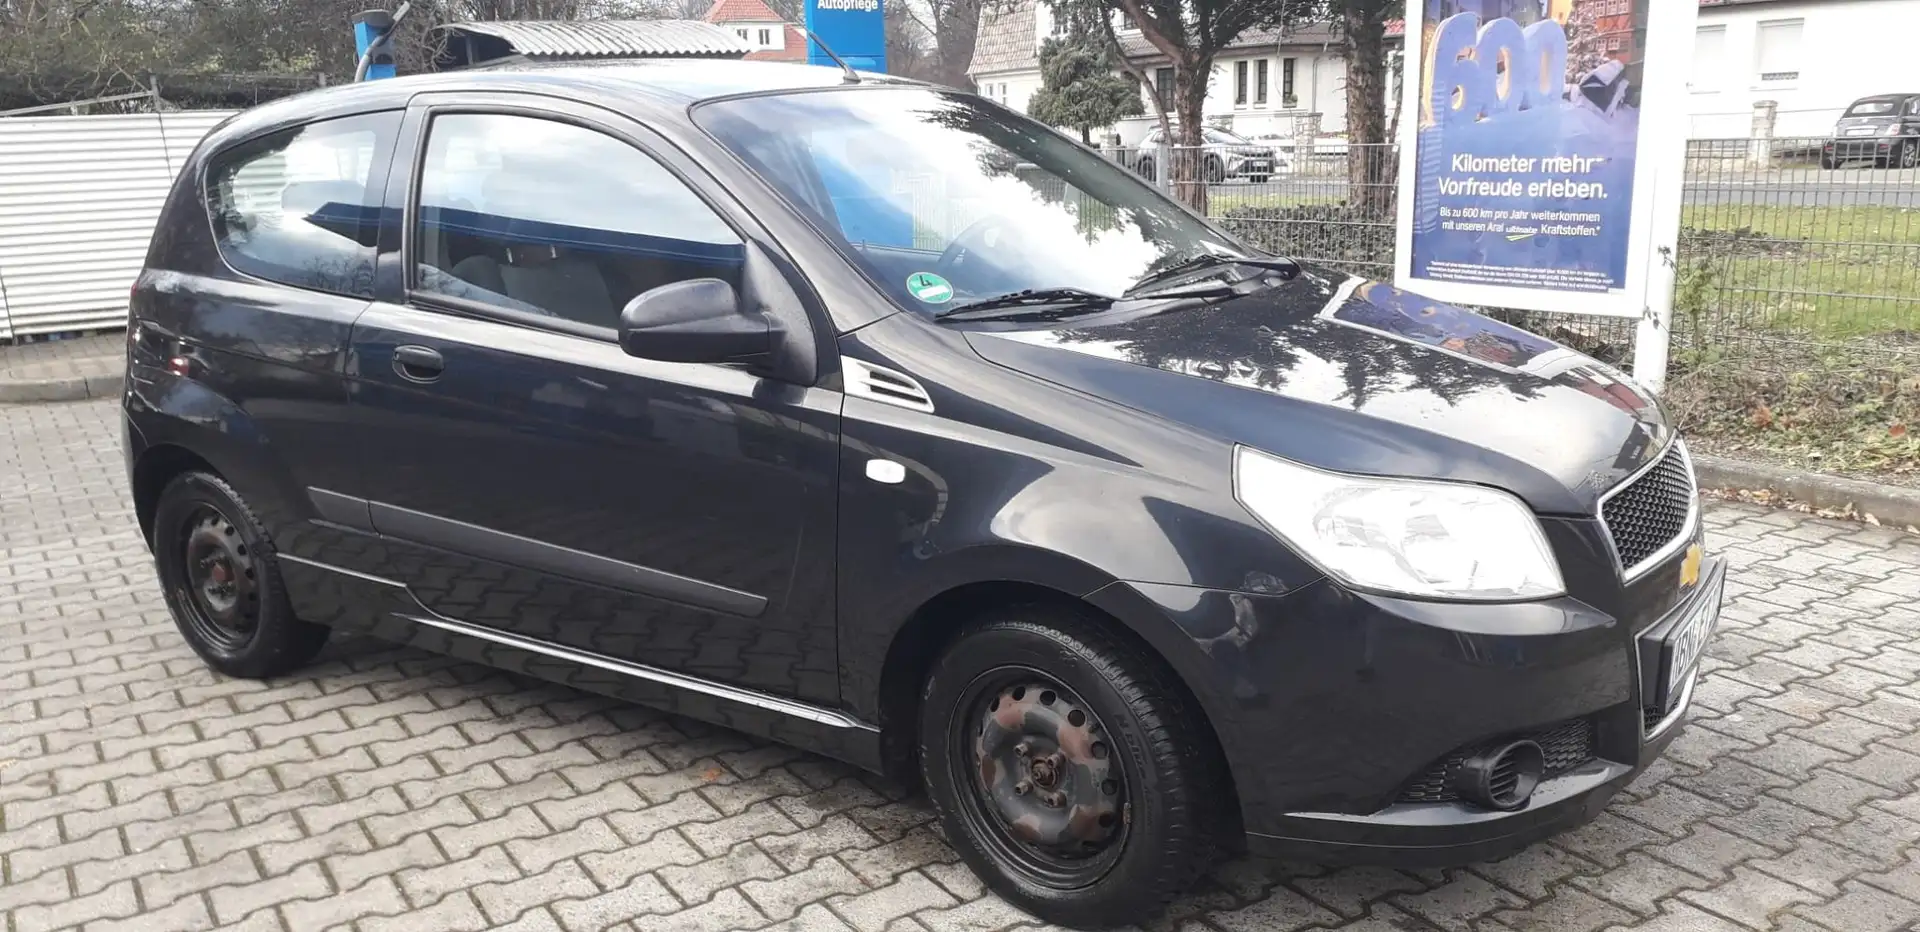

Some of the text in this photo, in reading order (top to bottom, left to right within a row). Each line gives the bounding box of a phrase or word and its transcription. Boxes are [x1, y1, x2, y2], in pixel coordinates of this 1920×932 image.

[817, 0, 879, 12] Autopflege
[1422, 11, 1568, 121] 600
[1452, 153, 1537, 173] Kilometer
[1438, 176, 1608, 199] Vorfreude erleben.
[1439, 206, 1601, 222] Bis zu 600 km pro Jahr weiterkommen
[1442, 220, 1454, 230] mit
[1455, 222, 1486, 232] unseren
[1486, 222, 1504, 233] Aral
